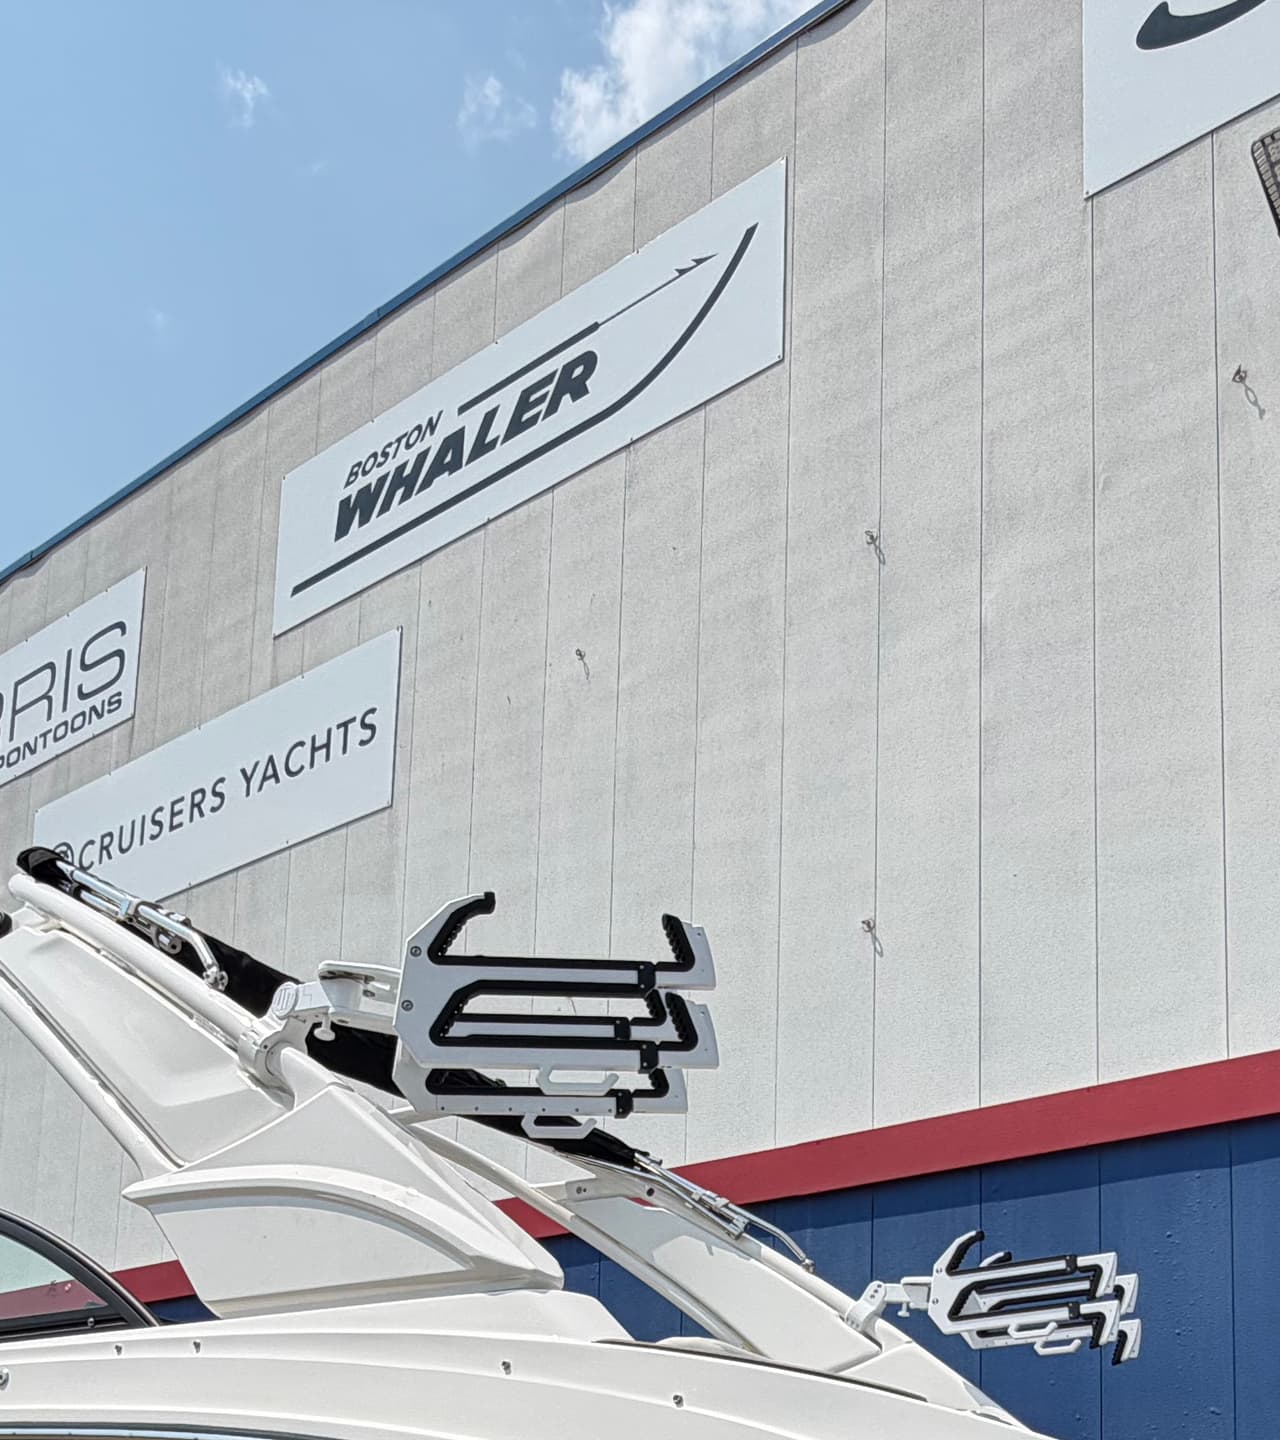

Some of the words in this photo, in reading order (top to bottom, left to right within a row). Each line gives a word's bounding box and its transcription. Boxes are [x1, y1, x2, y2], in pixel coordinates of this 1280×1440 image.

[334, 349, 599, 543] WHALER
[343, 410, 444, 489] BOSTON
[78, 776, 226, 873] CRUISERS
[240, 706, 378, 799] YACHTS
